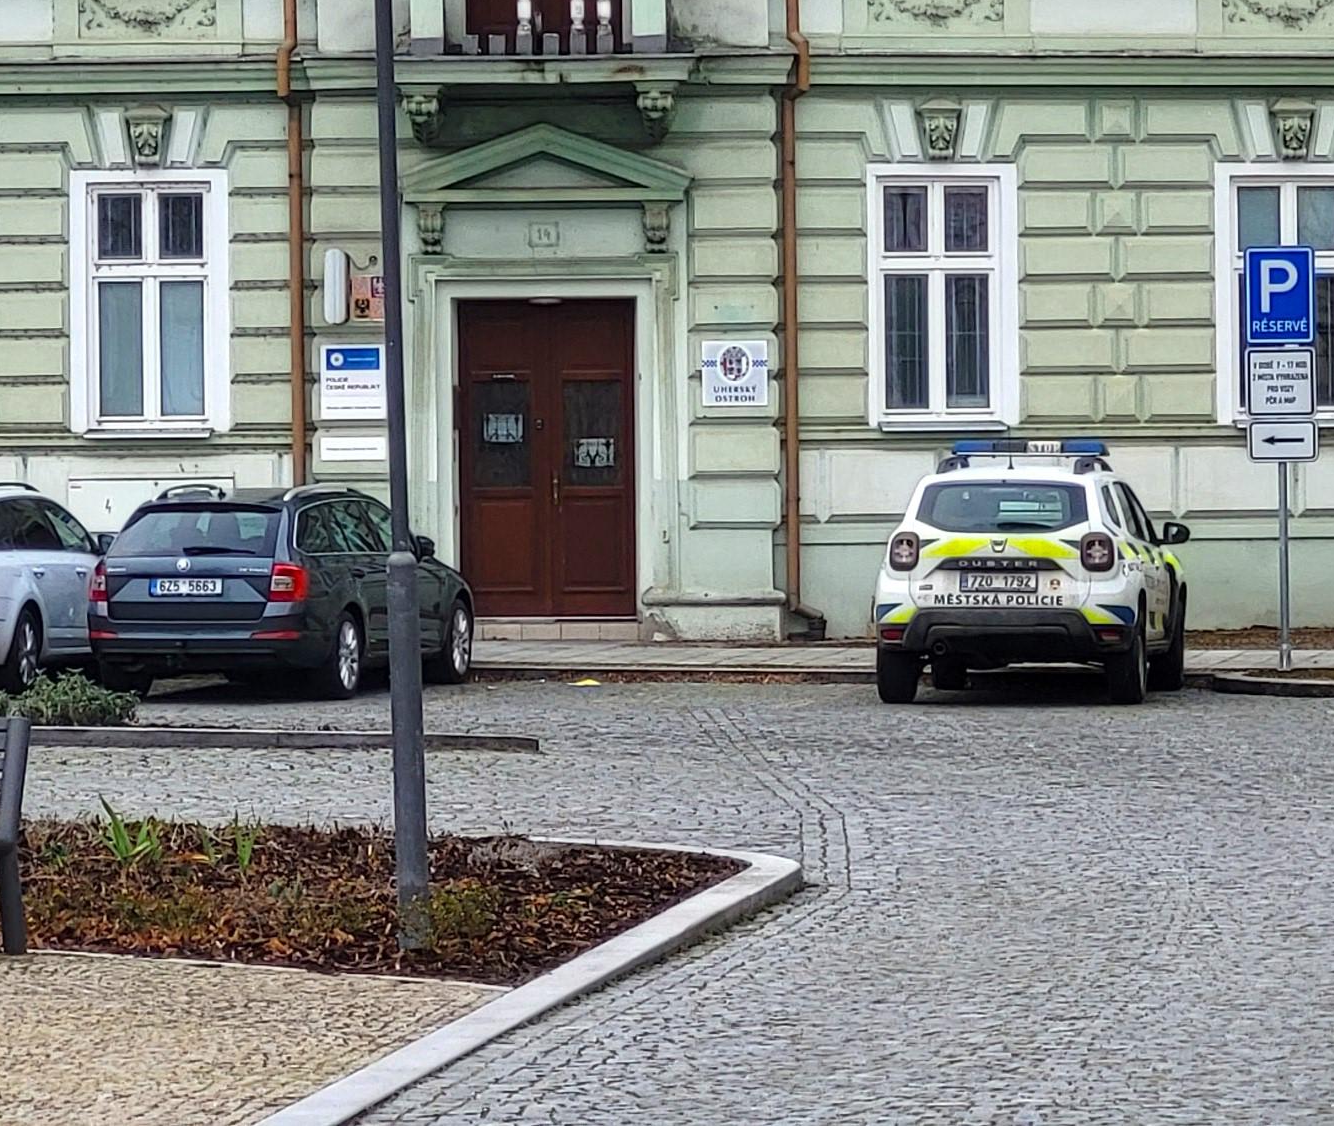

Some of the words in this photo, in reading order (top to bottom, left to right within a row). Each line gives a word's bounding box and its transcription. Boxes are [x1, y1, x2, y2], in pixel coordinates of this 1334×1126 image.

[1260, 258, 1299, 314] P
[1252, 317, 1308, 333] RÉSERVÉ
[712, 384, 757, 394] UHERSKÝ
[714, 394, 756, 403] OSTROH
[957, 560, 1038, 568] DUSTER
[1002, 575, 1032, 588] 1792
[933, 592, 1001, 606] MĚSTSKÁ
[1006, 594, 1064, 606] POLICIE
